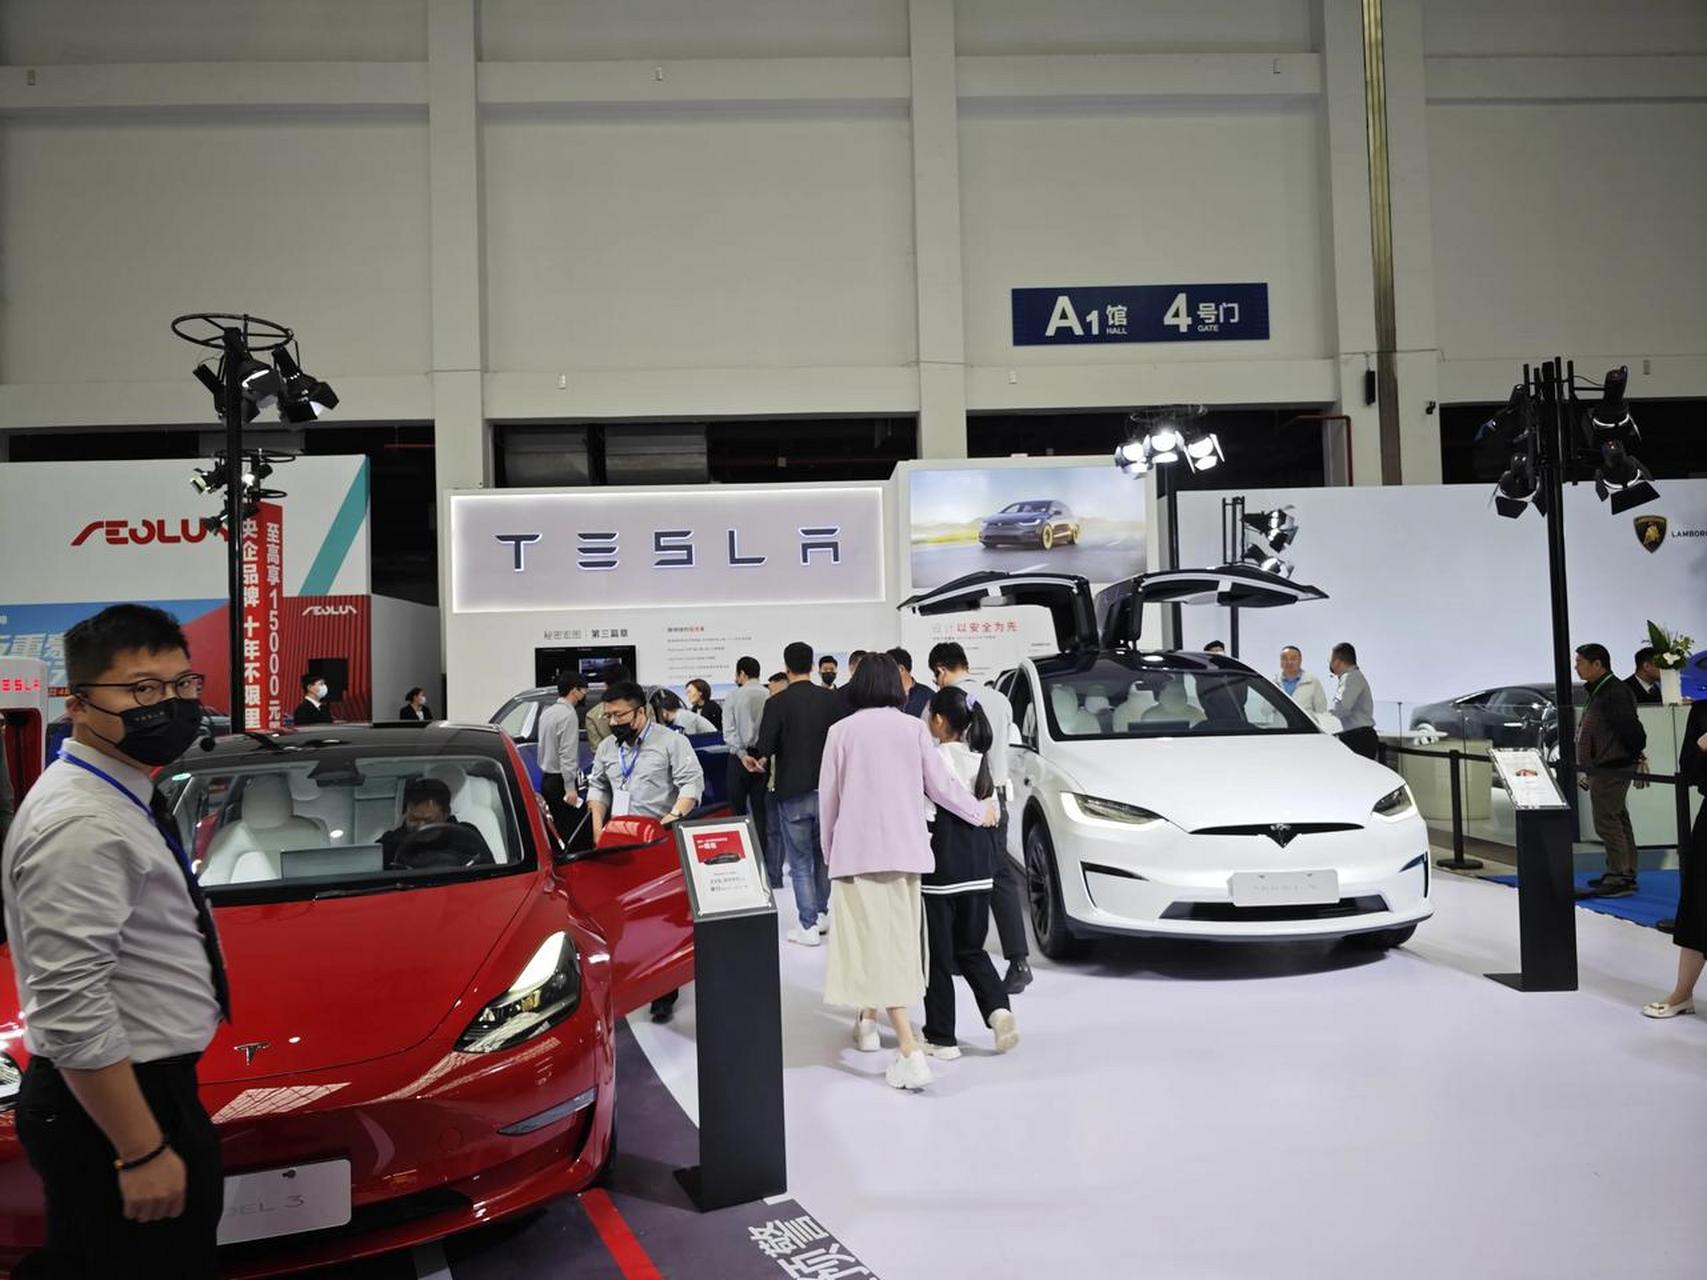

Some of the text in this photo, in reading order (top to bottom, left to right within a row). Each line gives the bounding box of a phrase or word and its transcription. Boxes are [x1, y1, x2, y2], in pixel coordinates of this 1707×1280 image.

[1106, 324, 1220, 336] HALL GATE
[495, 527, 842, 572] TESLA
